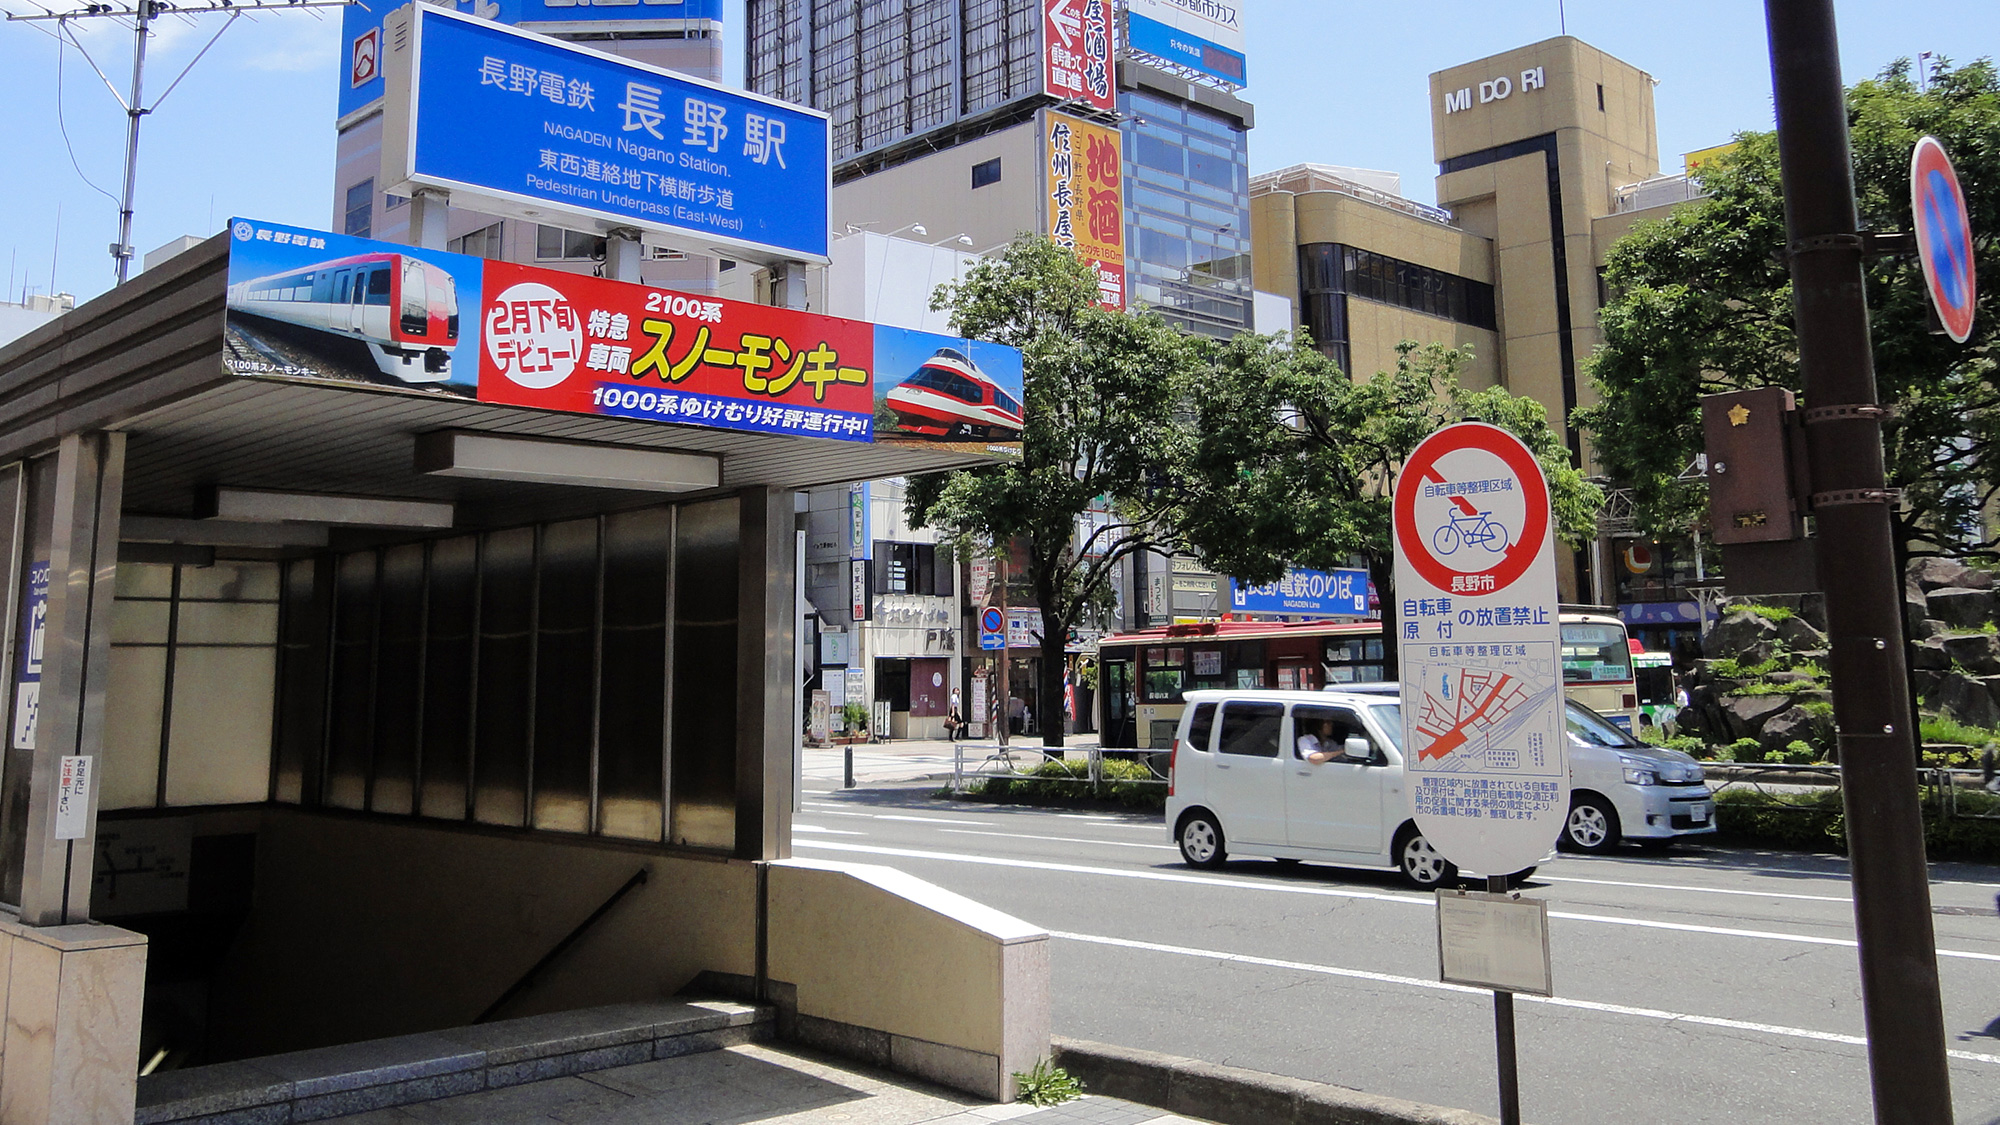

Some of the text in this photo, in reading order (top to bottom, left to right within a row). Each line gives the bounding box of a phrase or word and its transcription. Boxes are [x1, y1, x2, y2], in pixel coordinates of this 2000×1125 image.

[1066, 7, 1080, 19] この先
[1052, 66, 1082, 92] 直進
[478, 56, 787, 170] 長野電鉄 長野駅
[543, 121, 731, 178] NAGADEN Nagano Station.
[538, 148, 735, 210] 東西連絡地下横断歩道
[1086, 133, 1120, 247] 地酒
[525, 173, 744, 232] Pedestrian Underpass (East-West)
[255, 228, 326, 250] 長野電鉄
[492, 298, 575, 336] 2月下旬
[588, 308, 630, 342] 特急
[644, 293, 723, 324] 2100系
[226, 359, 318, 377] 2100系スノーモンキー
[588, 343, 632, 376] 車両
[631, 319, 868, 400] スノーモンキー
[592, 387, 868, 436] 1000系ゆけむり好評運行中!
[1424, 478, 1513, 498] 自転車等整理区域
[1451, 574, 1495, 592] 長野市
[1283, 600, 1320, 609] NAGADEN Line
[1403, 598, 1453, 617] 自転車
[1458, 606, 1550, 627] の放置禁止
[1429, 644, 1527, 657] 自転車等整理区域
[59, 758, 73, 817] ご注意下さい。
[75, 758, 86, 796] お足元に
